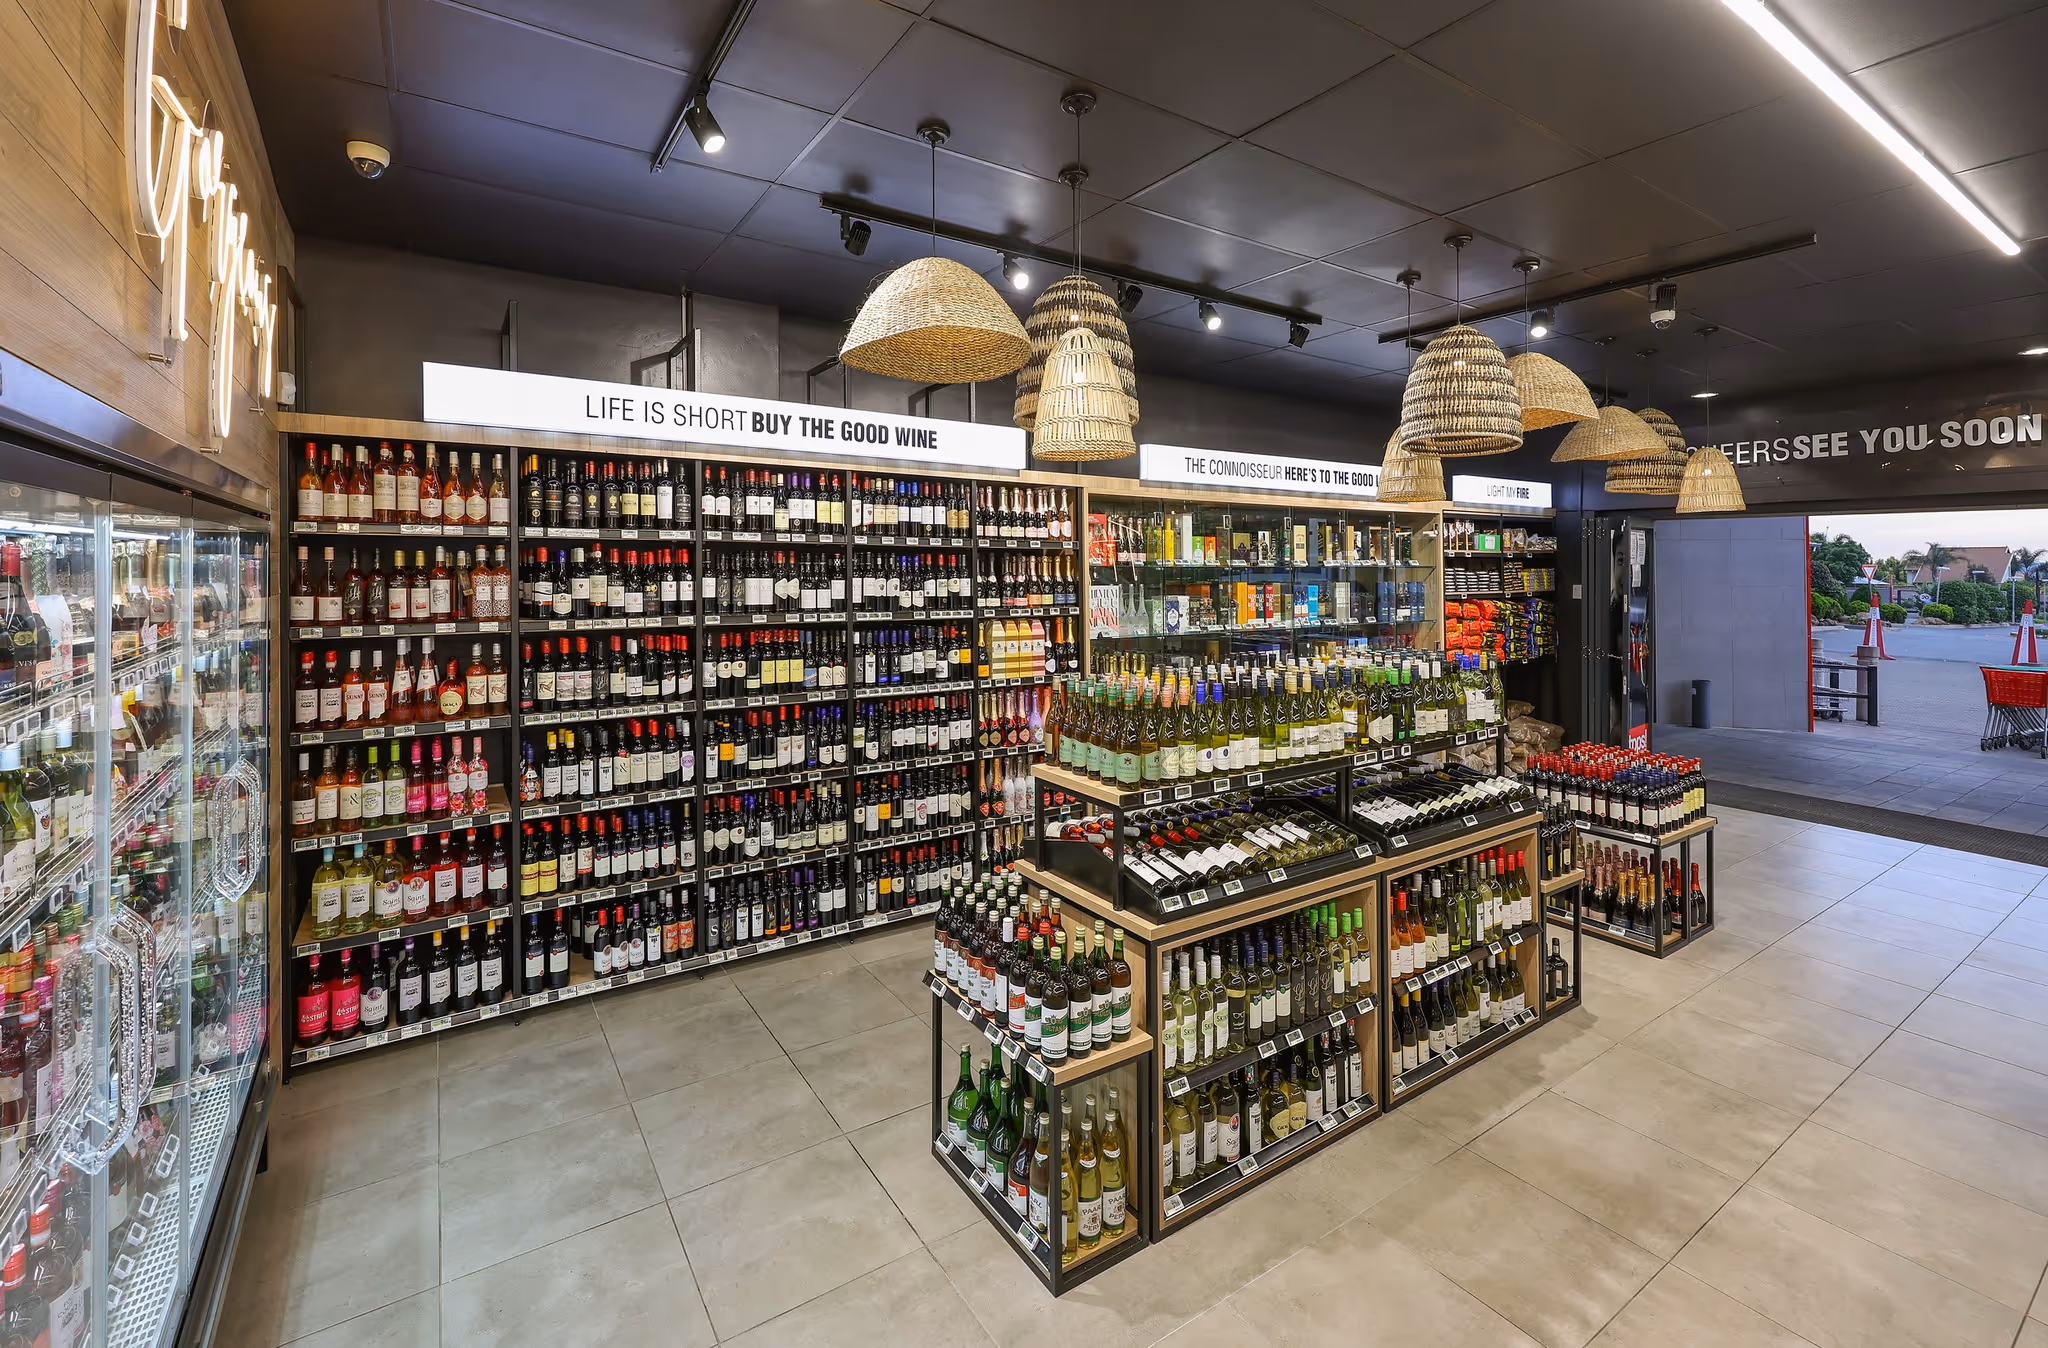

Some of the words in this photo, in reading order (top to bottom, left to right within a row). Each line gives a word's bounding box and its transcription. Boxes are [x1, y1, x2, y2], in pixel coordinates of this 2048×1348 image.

[586, 395, 634, 421] LIFE
[644, 400, 665, 424] IS
[674, 404, 748, 431] SHORT
[752, 411, 792, 436] BUY
[799, 416, 834, 439] THE
[841, 421, 889, 445] GOOD
[895, 426, 938, 449] WINE
[1792, 431, 1849, 460] SEE
[1859, 424, 1928, 454] YOU
[1940, 413, 2042, 448] SOON
[1185, 457, 1206, 474] THE
[1209, 459, 1283, 480] CONNOISSEUR
[1285, 466, 1317, 483] HERE'S
[1319, 469, 1331, 484] TO
[1333, 471, 1350, 486] THE
[1352, 472, 1374, 487] GOOD
[1487, 485, 1505, 497] LIGHT
[1506, 486, 1516, 498] MY
[1516, 487, 1530, 499] FIRE
